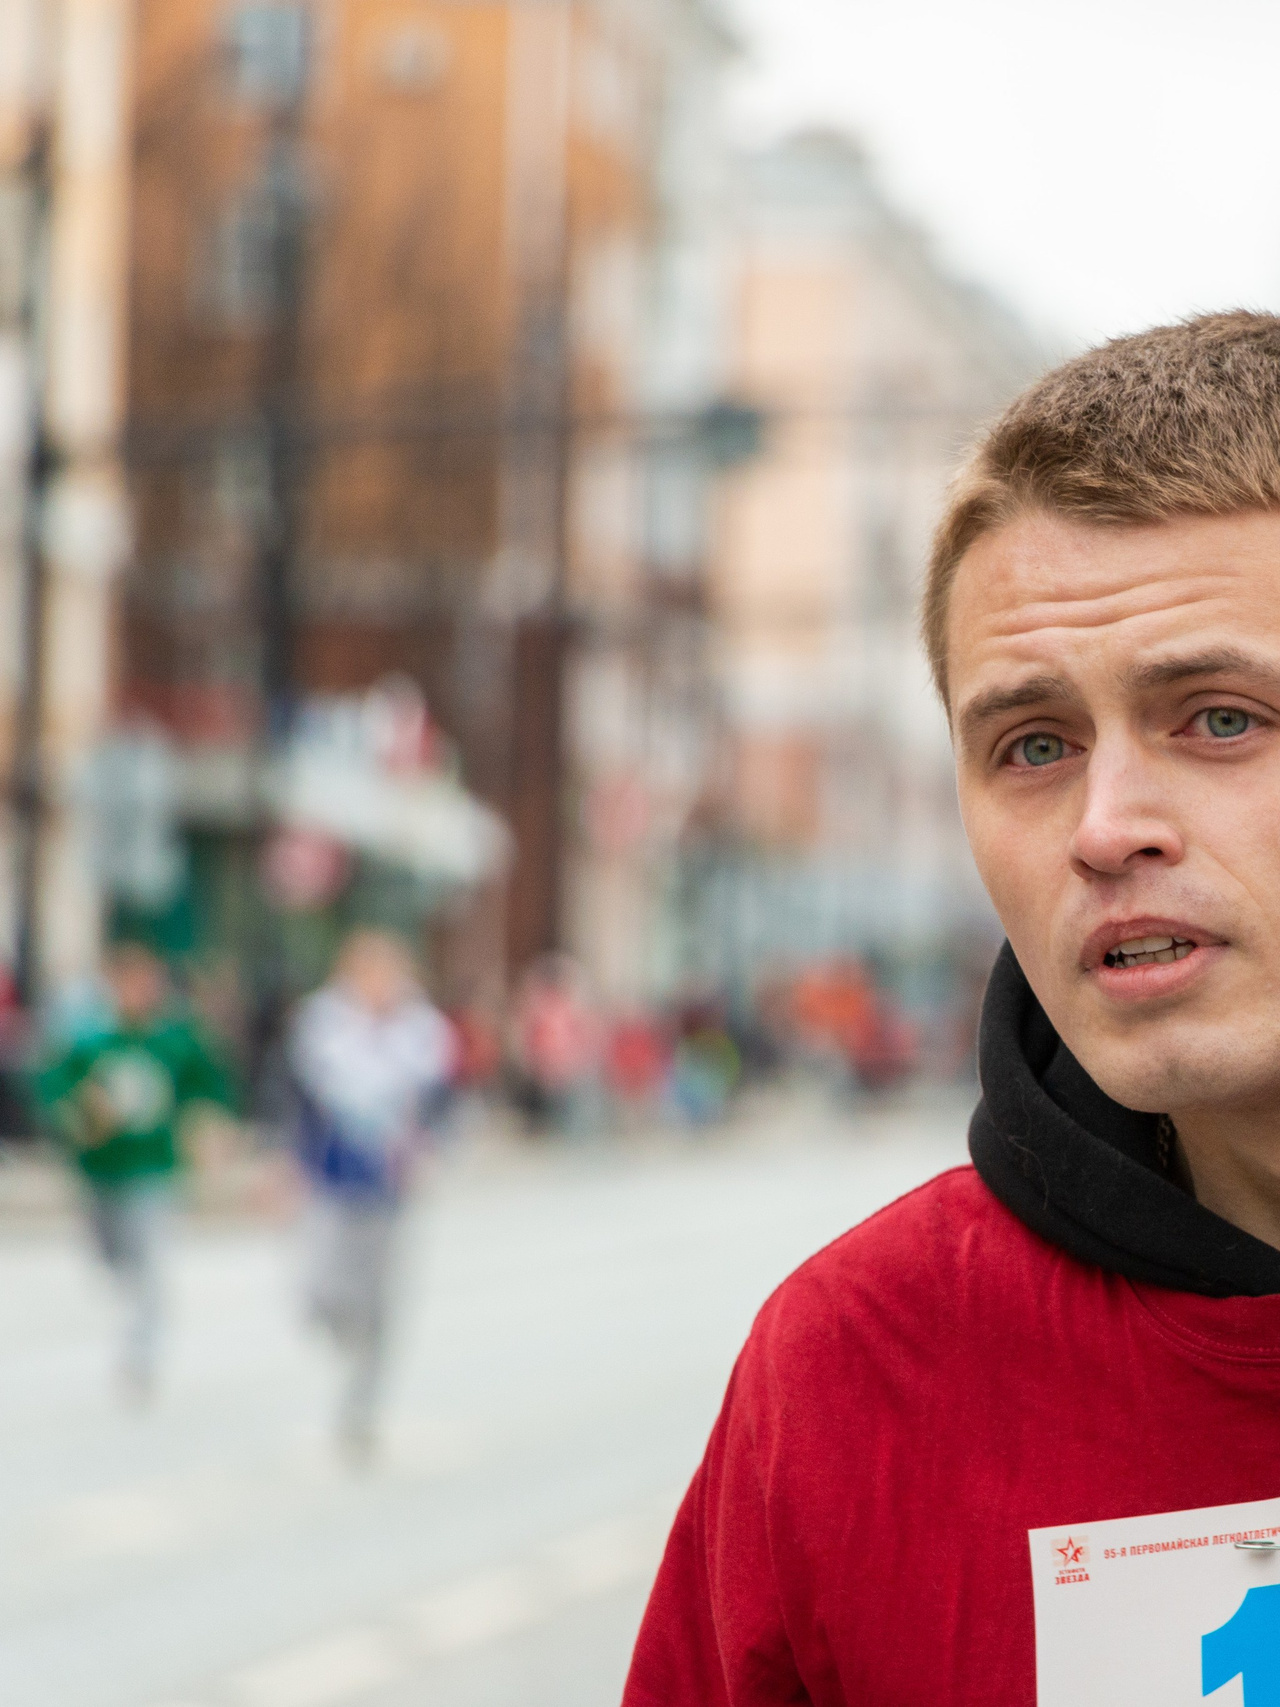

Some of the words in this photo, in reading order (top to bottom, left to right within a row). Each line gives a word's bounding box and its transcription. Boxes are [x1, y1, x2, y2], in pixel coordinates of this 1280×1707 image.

[1103, 1548, 1127, 1559] 95-Я
[1130, 1537, 1209, 1556] ПЕРВОМАЙСКАЯ
[1055, 1573, 1090, 1585] ЗВЕЗДА
